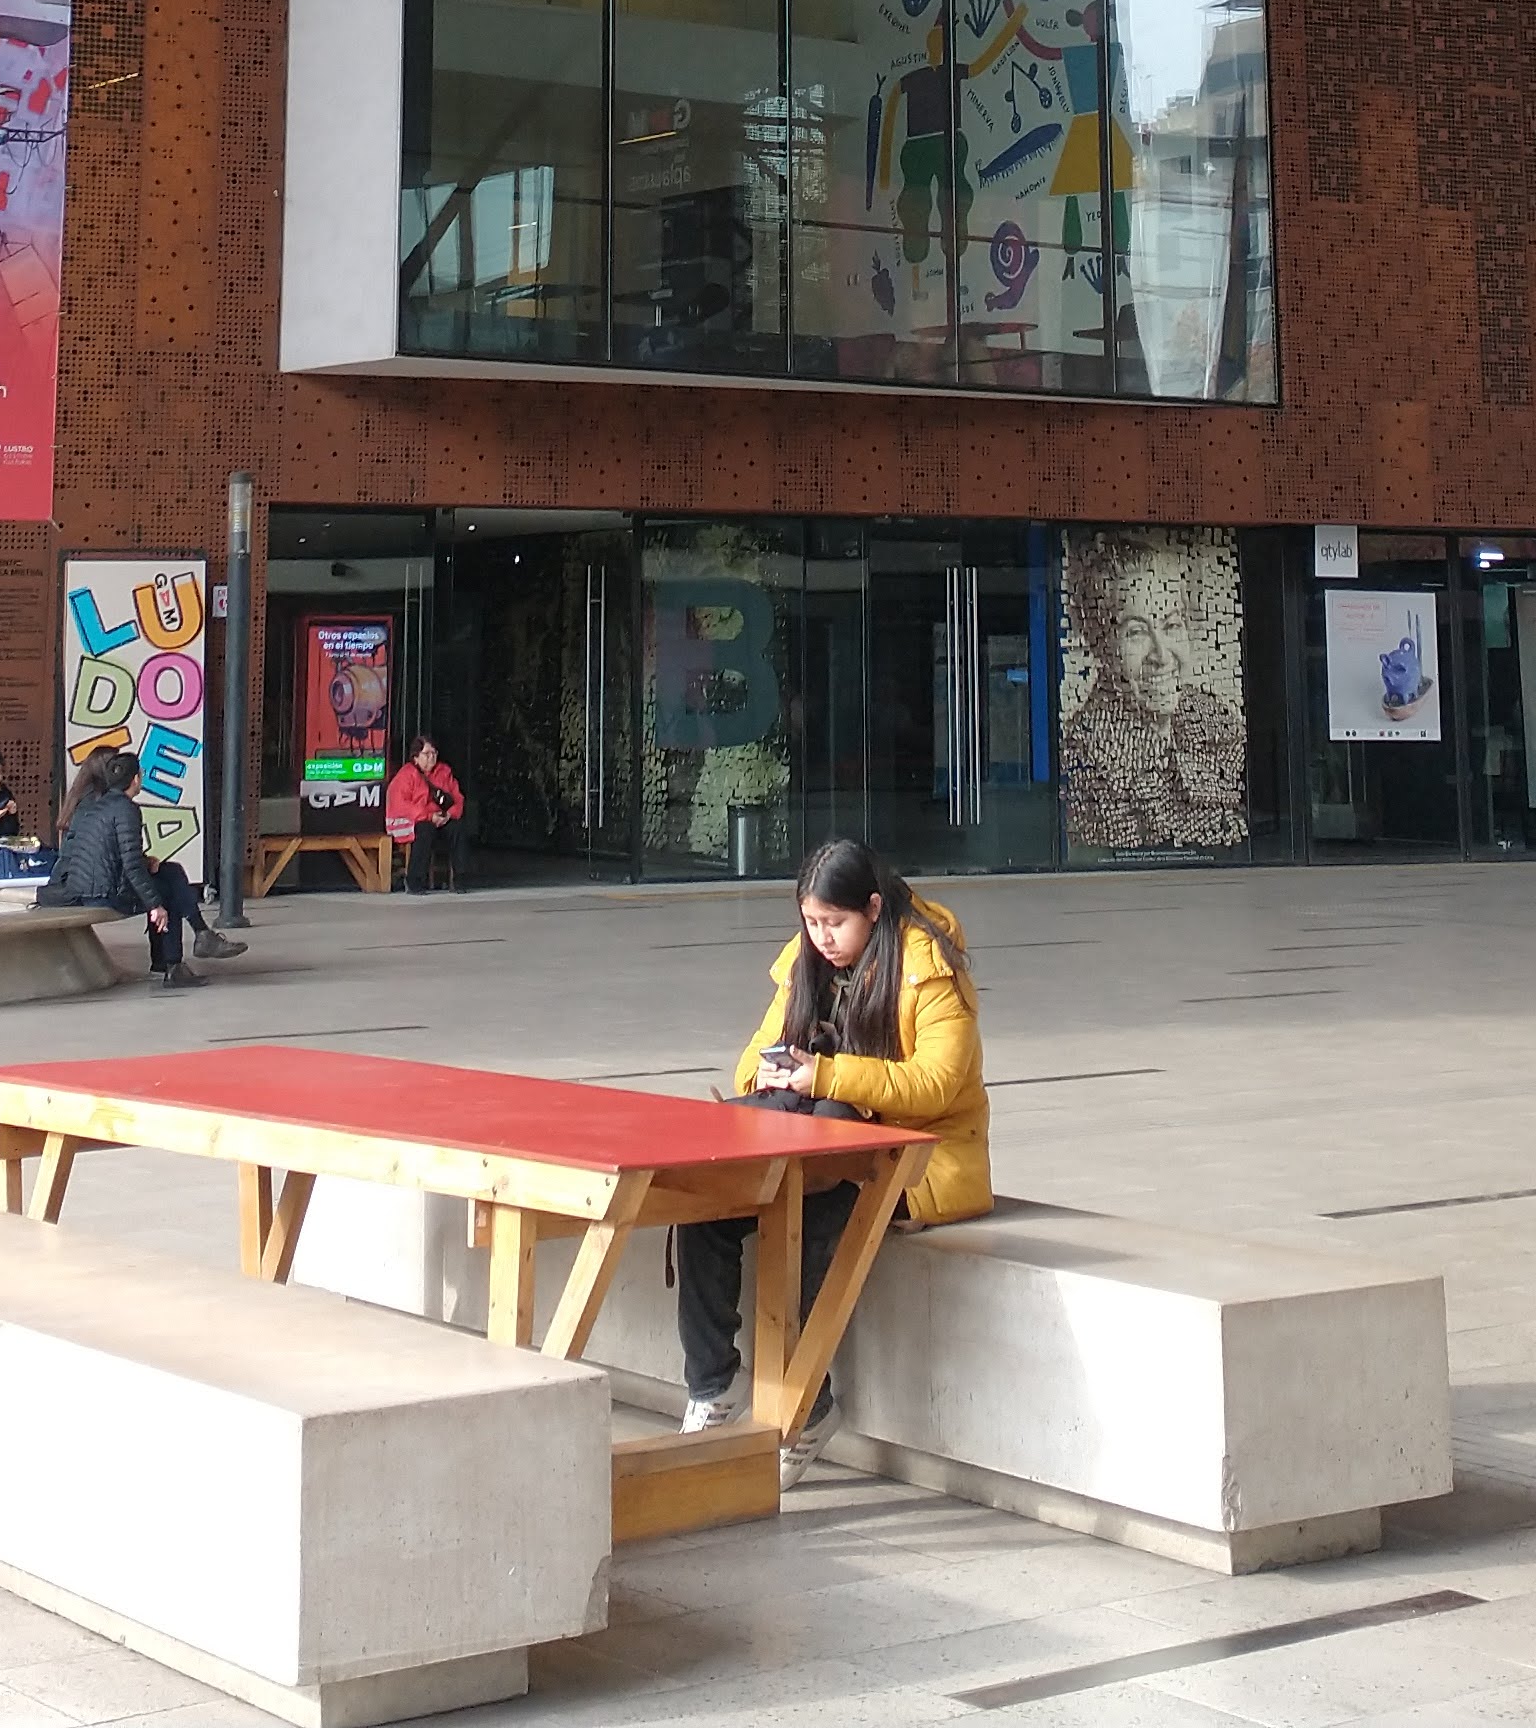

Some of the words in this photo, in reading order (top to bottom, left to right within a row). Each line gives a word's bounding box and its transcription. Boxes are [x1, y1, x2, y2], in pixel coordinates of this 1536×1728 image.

[966, 88, 994, 133] MINERVA
[154, 573, 178, 625] GAM
[318, 631, 341, 640] Otros
[343, 631, 379, 641] espacios
[323, 642, 334, 650] en
[335, 641, 343, 649] el
[345, 641, 373, 651] tiempo
[353, 762, 383, 772] GAM
[308, 783, 380, 809] GAM
